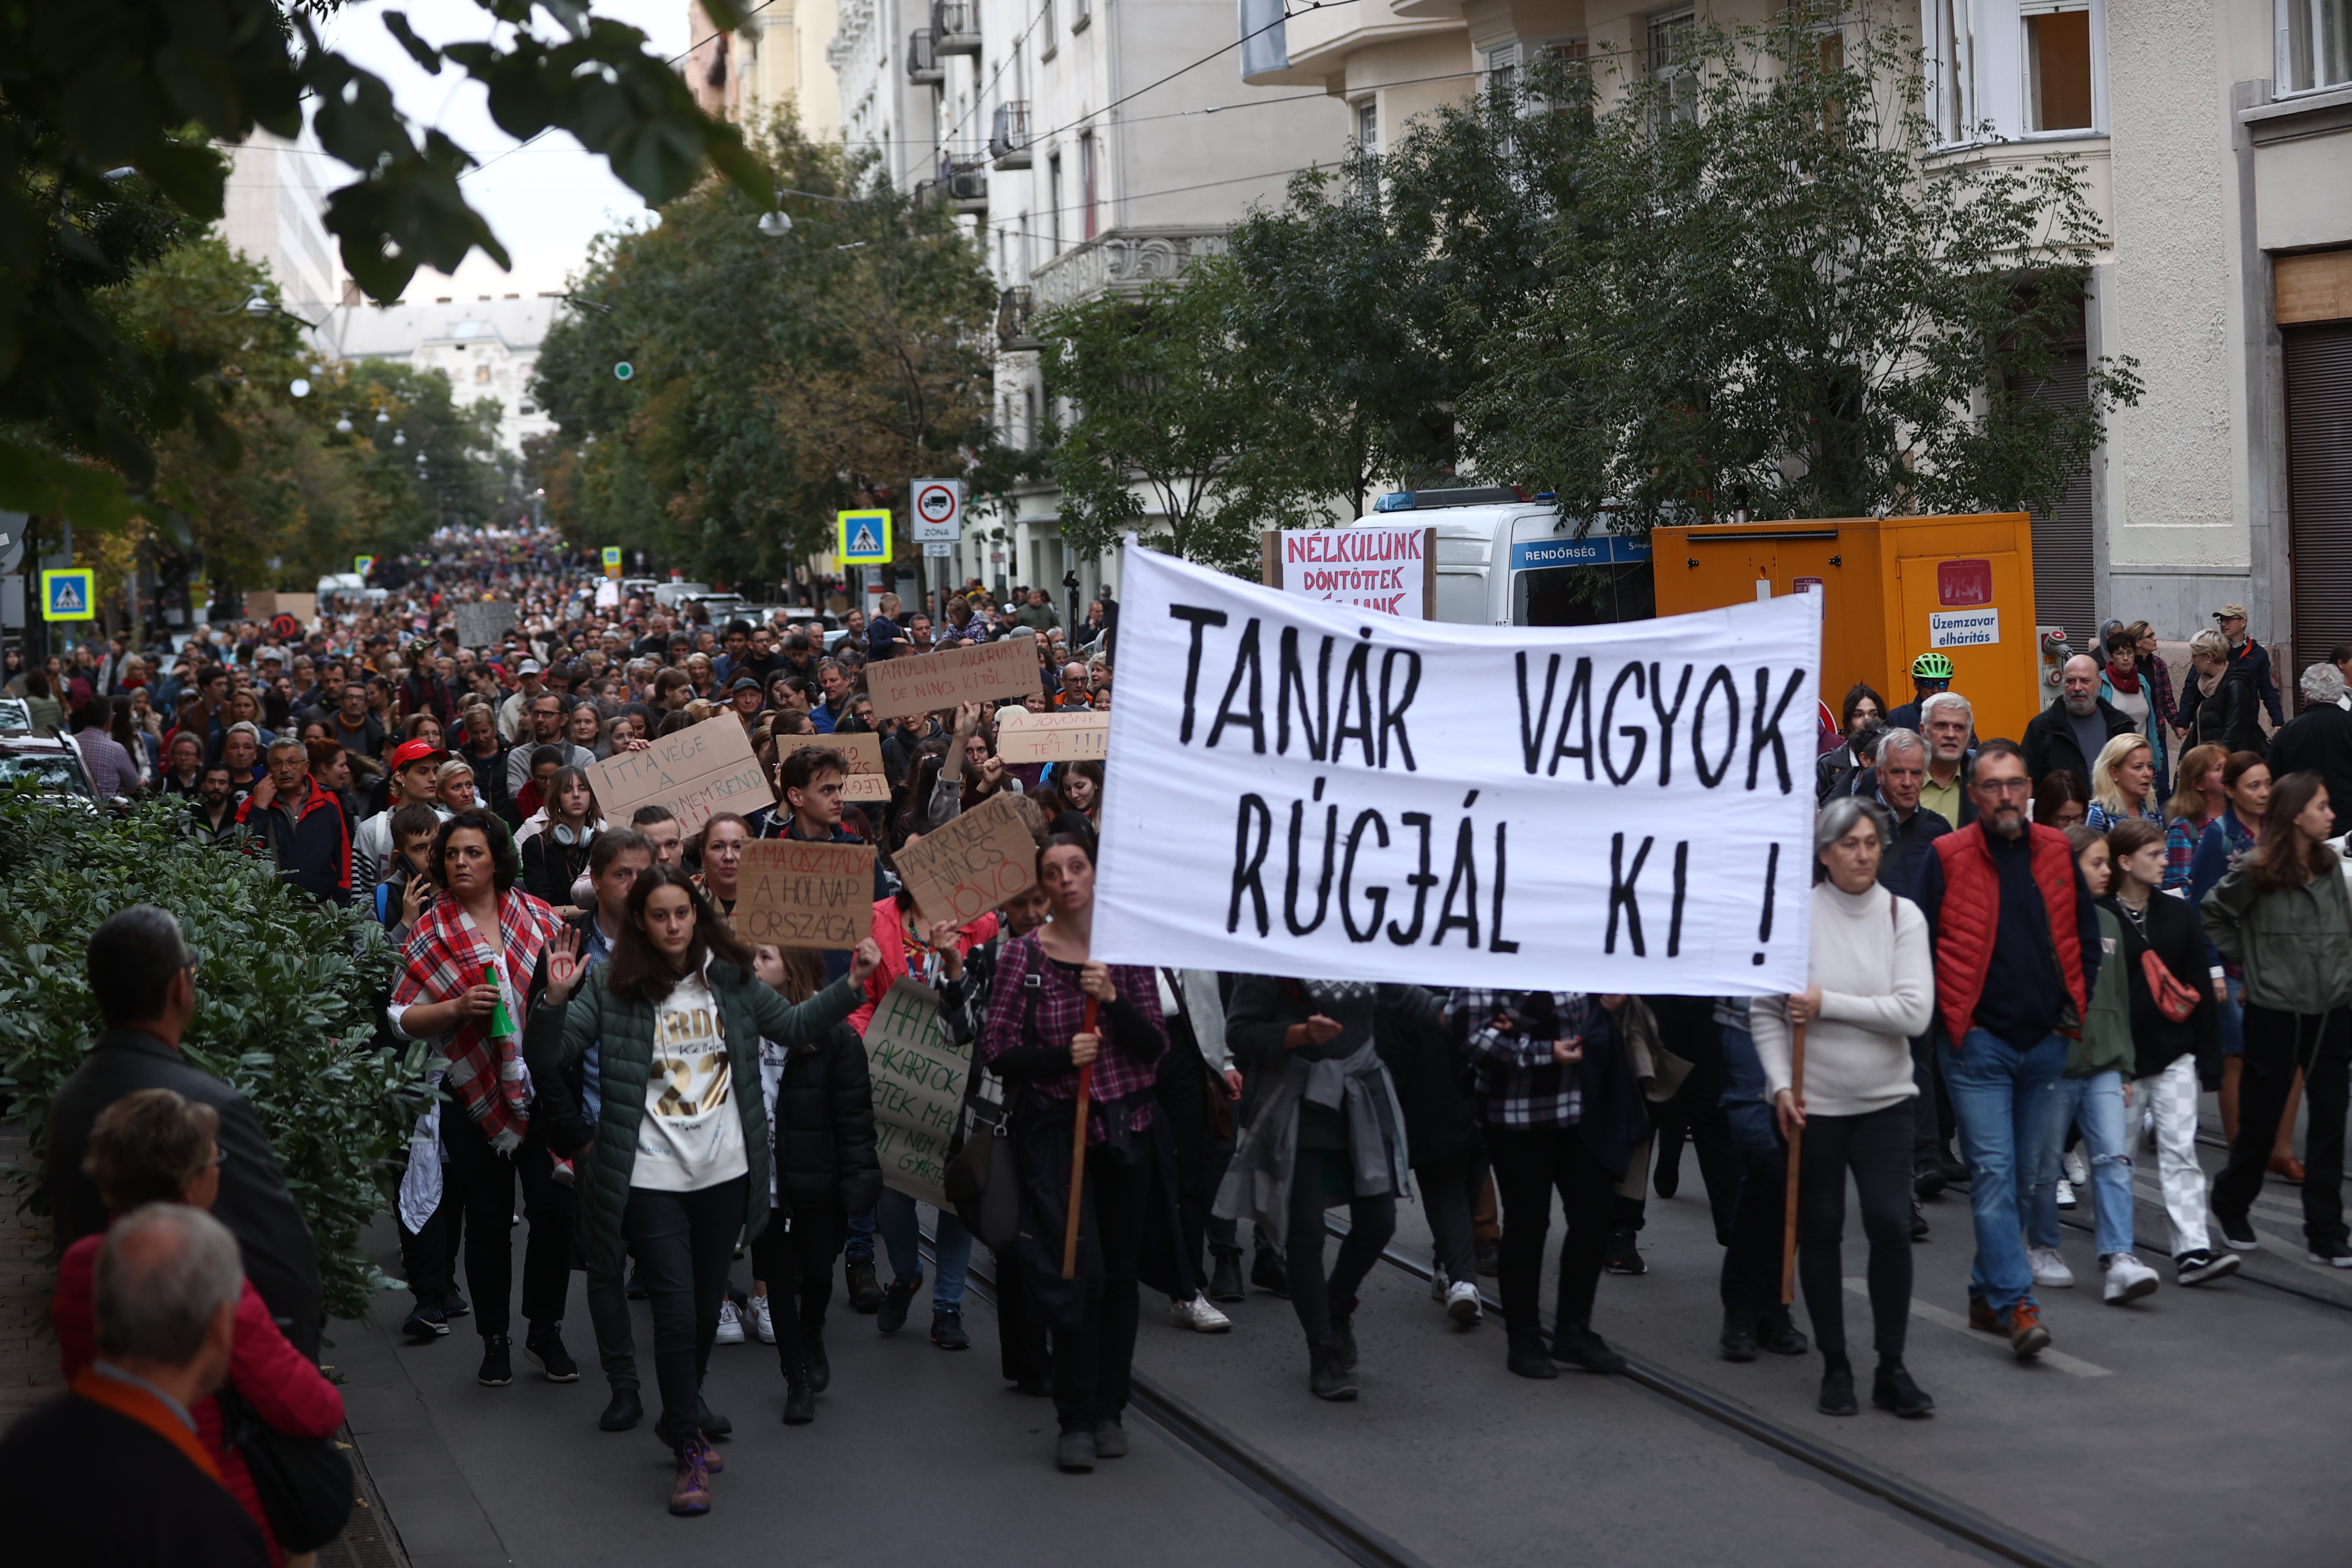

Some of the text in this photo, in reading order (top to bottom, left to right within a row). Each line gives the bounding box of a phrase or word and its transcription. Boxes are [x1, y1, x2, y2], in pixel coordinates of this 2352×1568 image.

[924, 527, 949, 536] ZÓNA
[1288, 530, 1421, 563] NÉLKÜLÜNK
[1525, 546, 1596, 560] RENDŐRSÉG
[1304, 567, 1404, 590] DÖNTÖTTEK
[1933, 614, 1995, 630] Üzemzavar
[1939, 631, 1990, 645] elhárítás
[960, 643, 1029, 668] AKARUNK,
[891, 688, 907, 701] DE
[915, 681, 955, 698] NINCS
[1170, 604, 1806, 794] TANÁR VAGYOK
[1032, 713, 1096, 727] JÖVŐNK
[1045, 730, 1059, 741] A
[644, 753, 660, 773] A
[659, 735, 707, 764] VÉGE
[659, 772, 675, 790] A
[679, 769, 763, 814] NEM REND
[745, 845, 874, 875] A MA OSZTÁLYA
[895, 832, 953, 876] TANÁR
[928, 835, 1004, 891] NINCS
[1227, 777, 1779, 966] RÚGJÁL KI !
[754, 875, 859, 908] A HOLNAP
[749, 910, 856, 942] ORSZÁGA
[884, 991, 923, 1042] HA
[870, 1039, 962, 1103] AKARTOK,
[869, 1073, 918, 1118] ÉTEK
[904, 1128, 940, 1157] NEM
